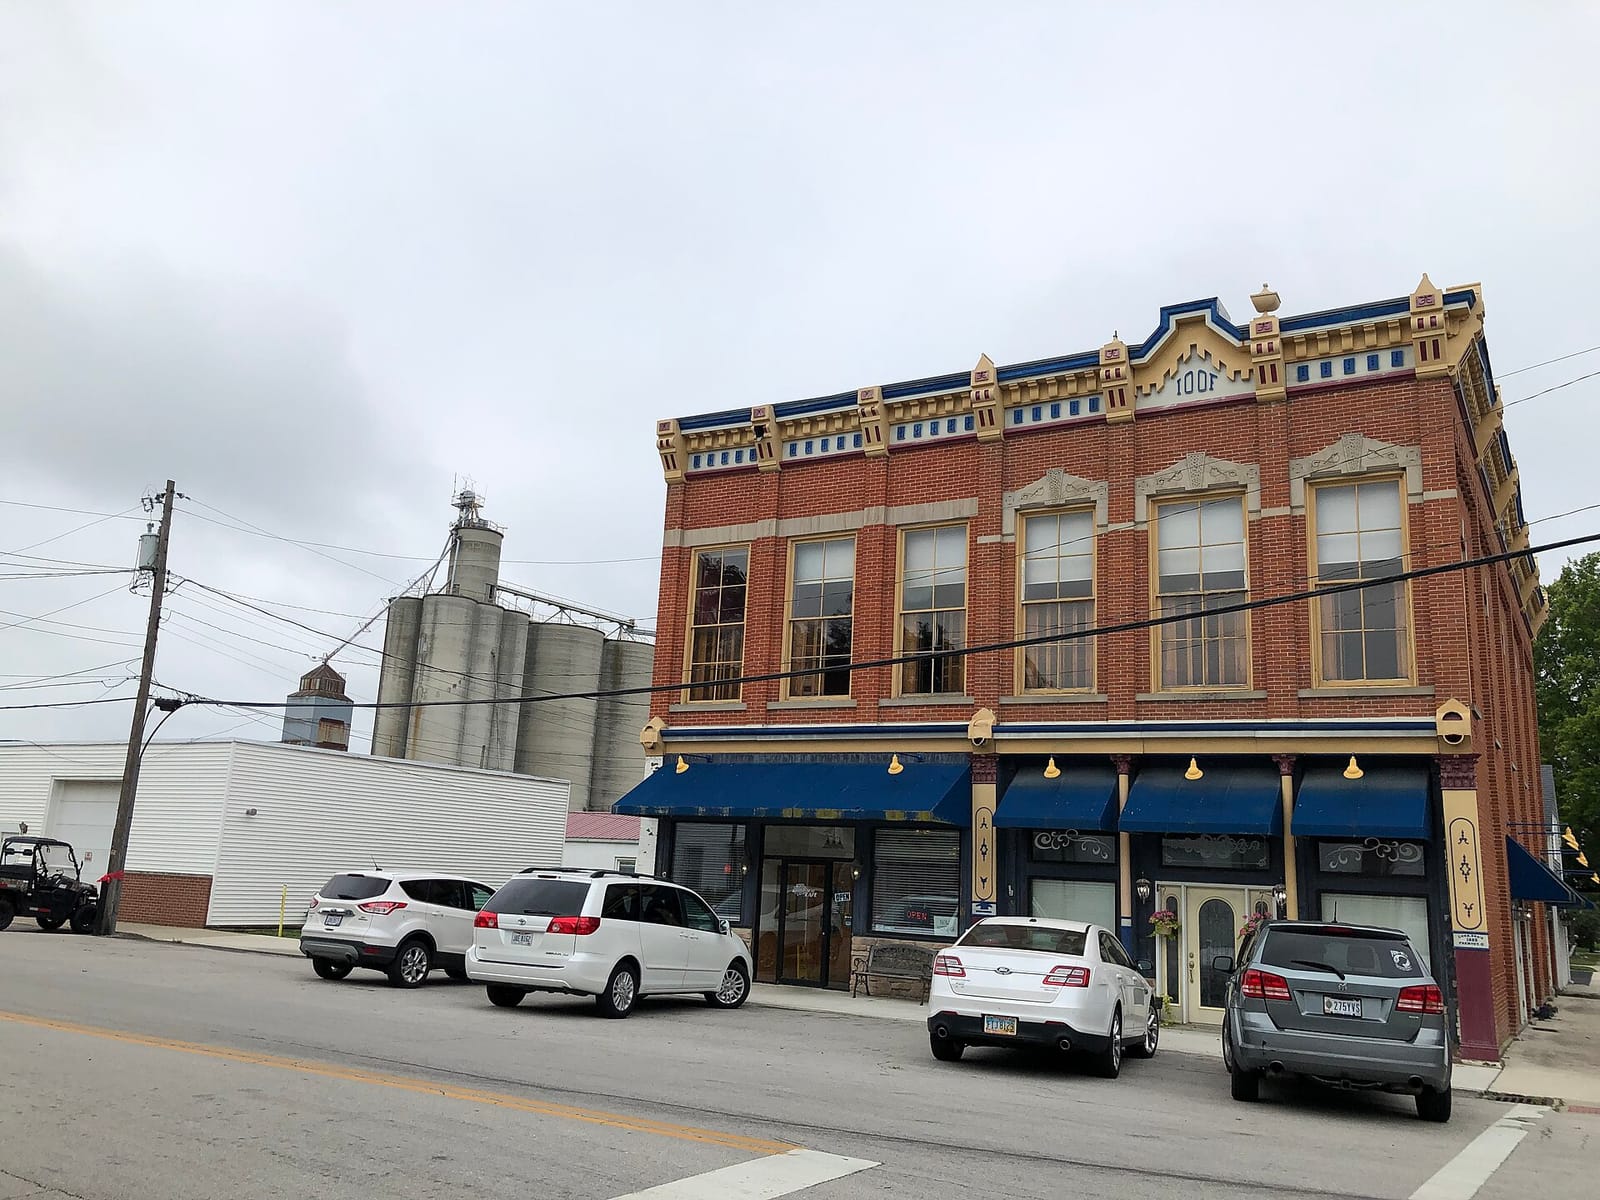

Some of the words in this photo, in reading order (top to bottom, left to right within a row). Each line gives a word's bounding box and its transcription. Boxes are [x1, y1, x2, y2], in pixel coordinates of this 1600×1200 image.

[1177, 369, 1218, 396] IOOF
[835, 892, 850, 901] OPEN
[906, 911, 928, 920] OPEN
